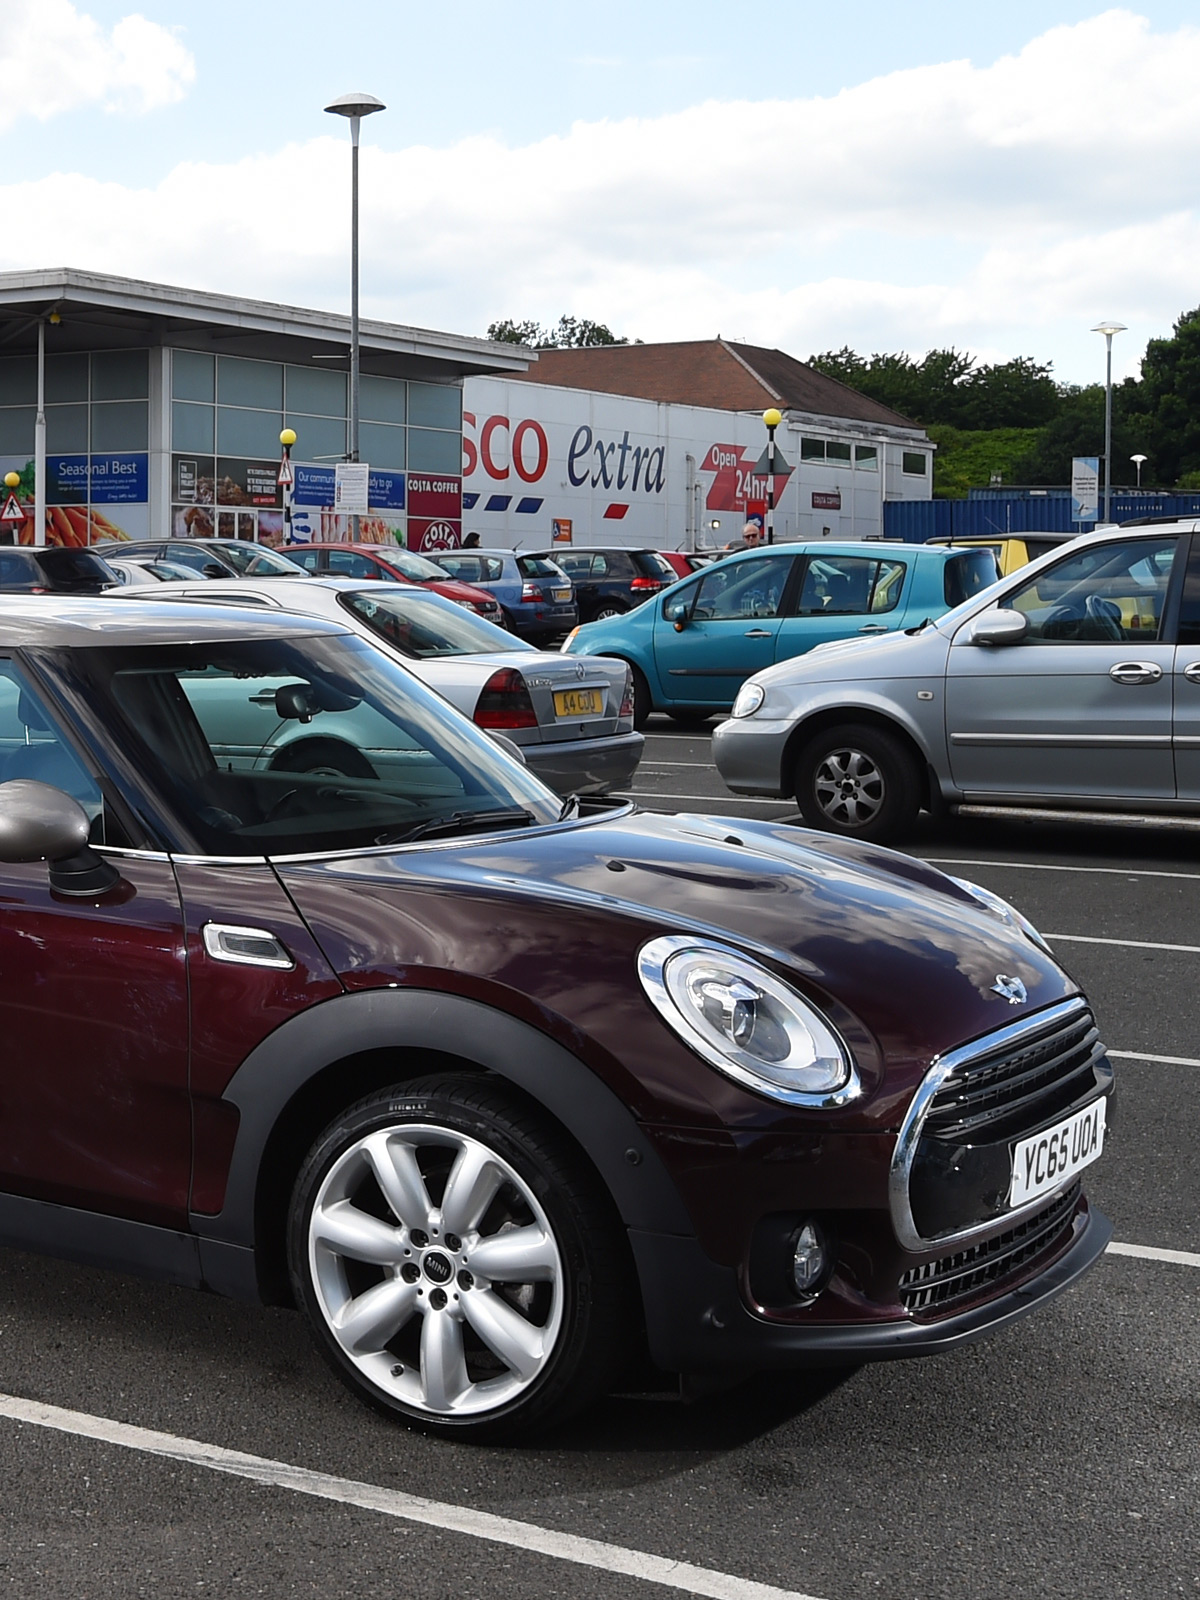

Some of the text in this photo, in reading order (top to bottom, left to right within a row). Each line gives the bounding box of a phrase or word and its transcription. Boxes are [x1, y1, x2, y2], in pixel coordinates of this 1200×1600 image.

[463, 411, 666, 494] SCO extra
[711, 446, 737, 471] Open
[58, 460, 137, 477] Seasonal Best
[298, 471, 393, 490] Our communi ady to go
[408, 479, 459, 494] COSTA COFFEE
[424, 523, 455, 550] COSTA
[1025, 1109, 1098, 1190] YC65 UOA
[426, 1258, 448, 1277] MINI
